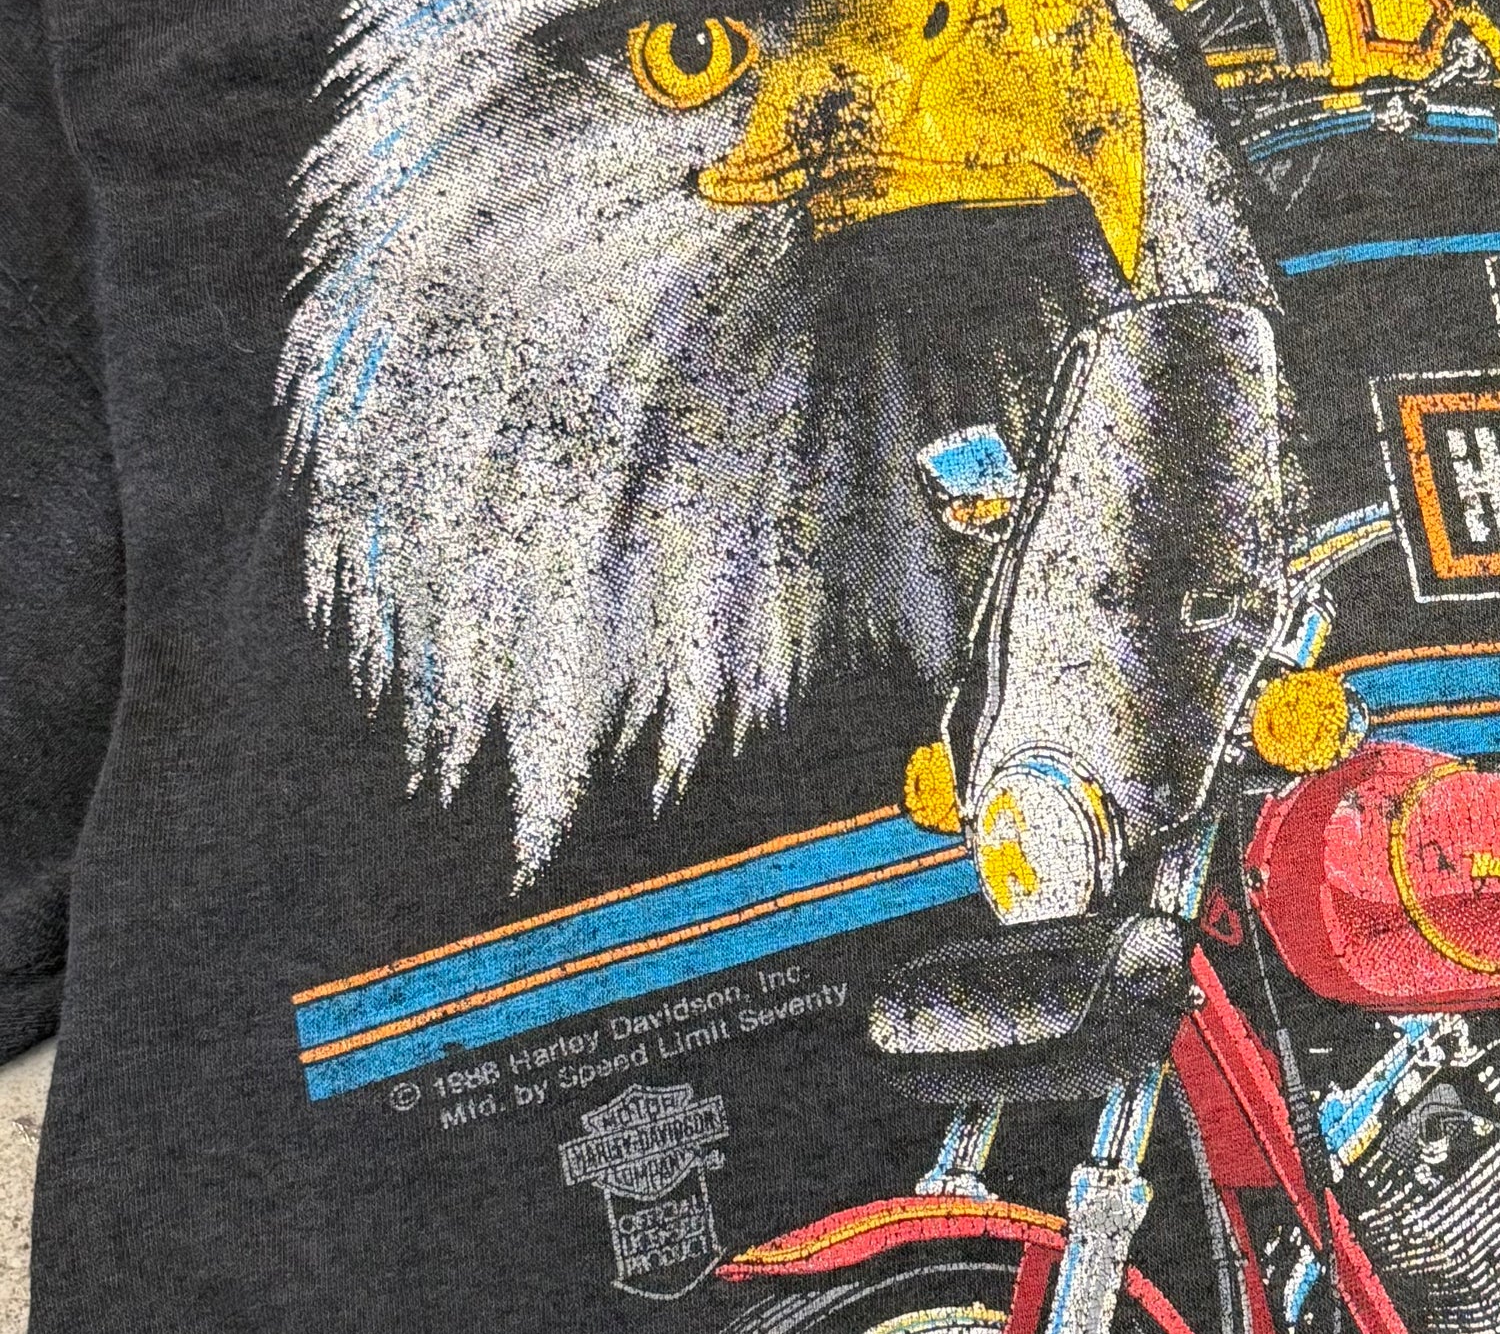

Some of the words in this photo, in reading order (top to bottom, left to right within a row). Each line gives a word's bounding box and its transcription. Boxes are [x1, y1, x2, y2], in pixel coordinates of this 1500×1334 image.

[509, 1030, 599, 1075] Harley
[514, 1079, 548, 1106] by
[558, 1043, 649, 1089] Speed
[658, 1018, 731, 1059] Limit
[738, 982, 848, 1033] Seventy
